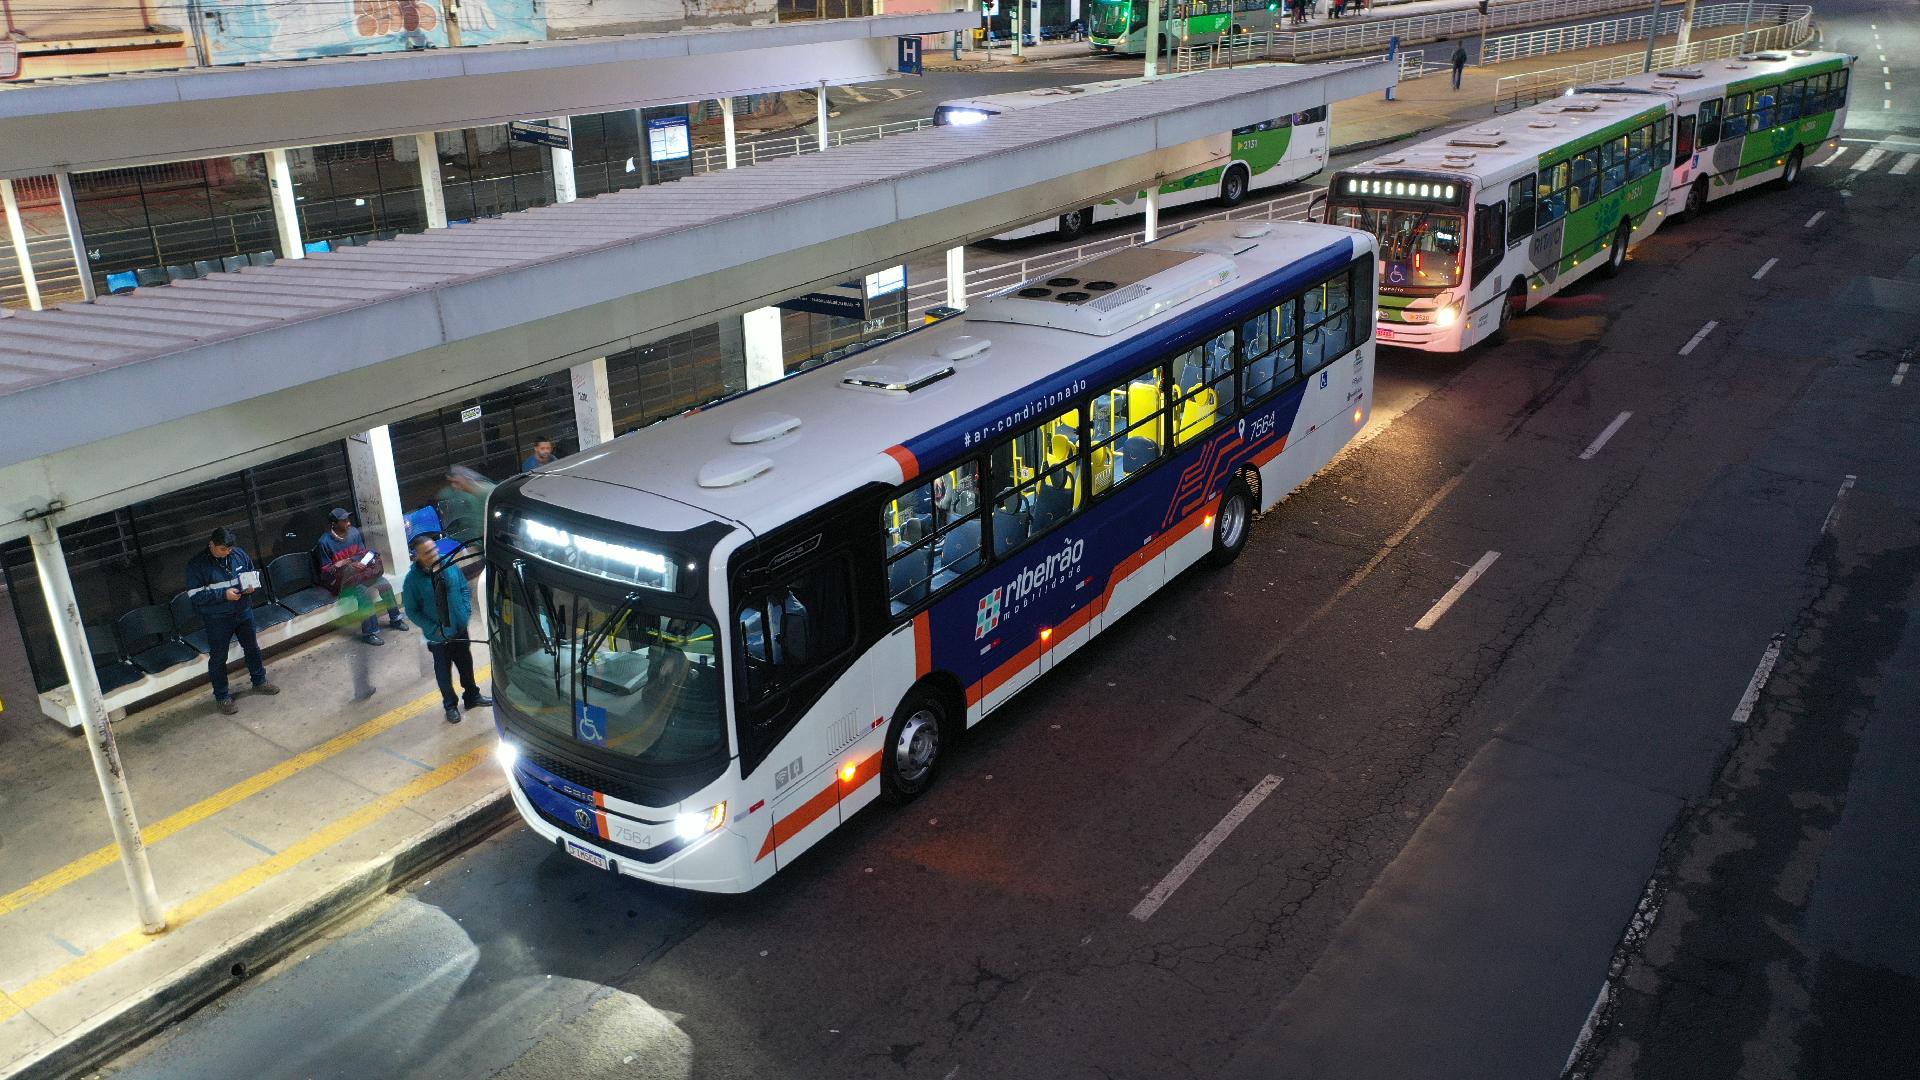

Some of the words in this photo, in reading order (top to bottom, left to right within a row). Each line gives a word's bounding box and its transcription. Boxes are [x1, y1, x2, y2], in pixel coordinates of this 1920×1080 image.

[903, 40, 916, 62] H
[964, 379, 1086, 448] #ar-condicionado
[1250, 410, 1275, 441] 7564
[1003, 565, 1081, 620] mobilidade
[1004, 537, 1084, 608] ribeirão
[615, 825, 652, 846] 7564
